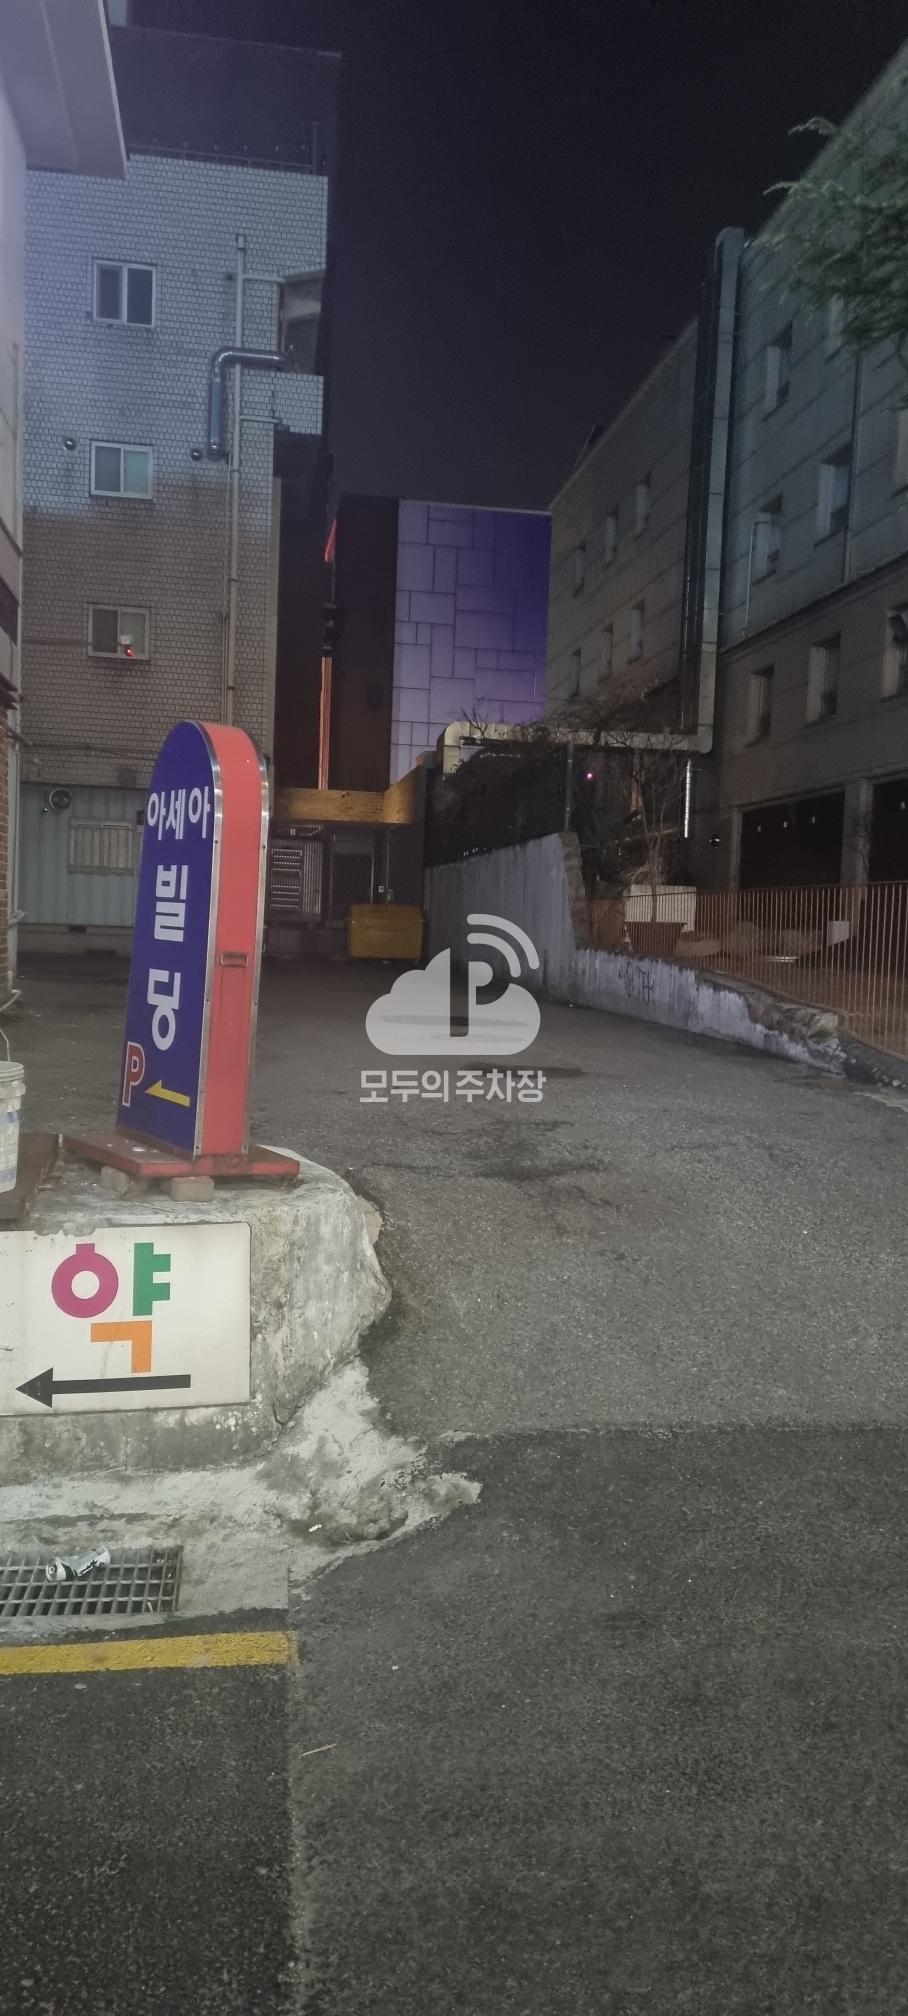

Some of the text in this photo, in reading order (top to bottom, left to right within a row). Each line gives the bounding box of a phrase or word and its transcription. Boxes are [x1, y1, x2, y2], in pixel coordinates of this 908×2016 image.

[147, 786, 211, 840] 아세아
[147, 865, 188, 1050] 빌딩
[121, 1041, 146, 1107] P
[51, 1242, 171, 1374] 약
